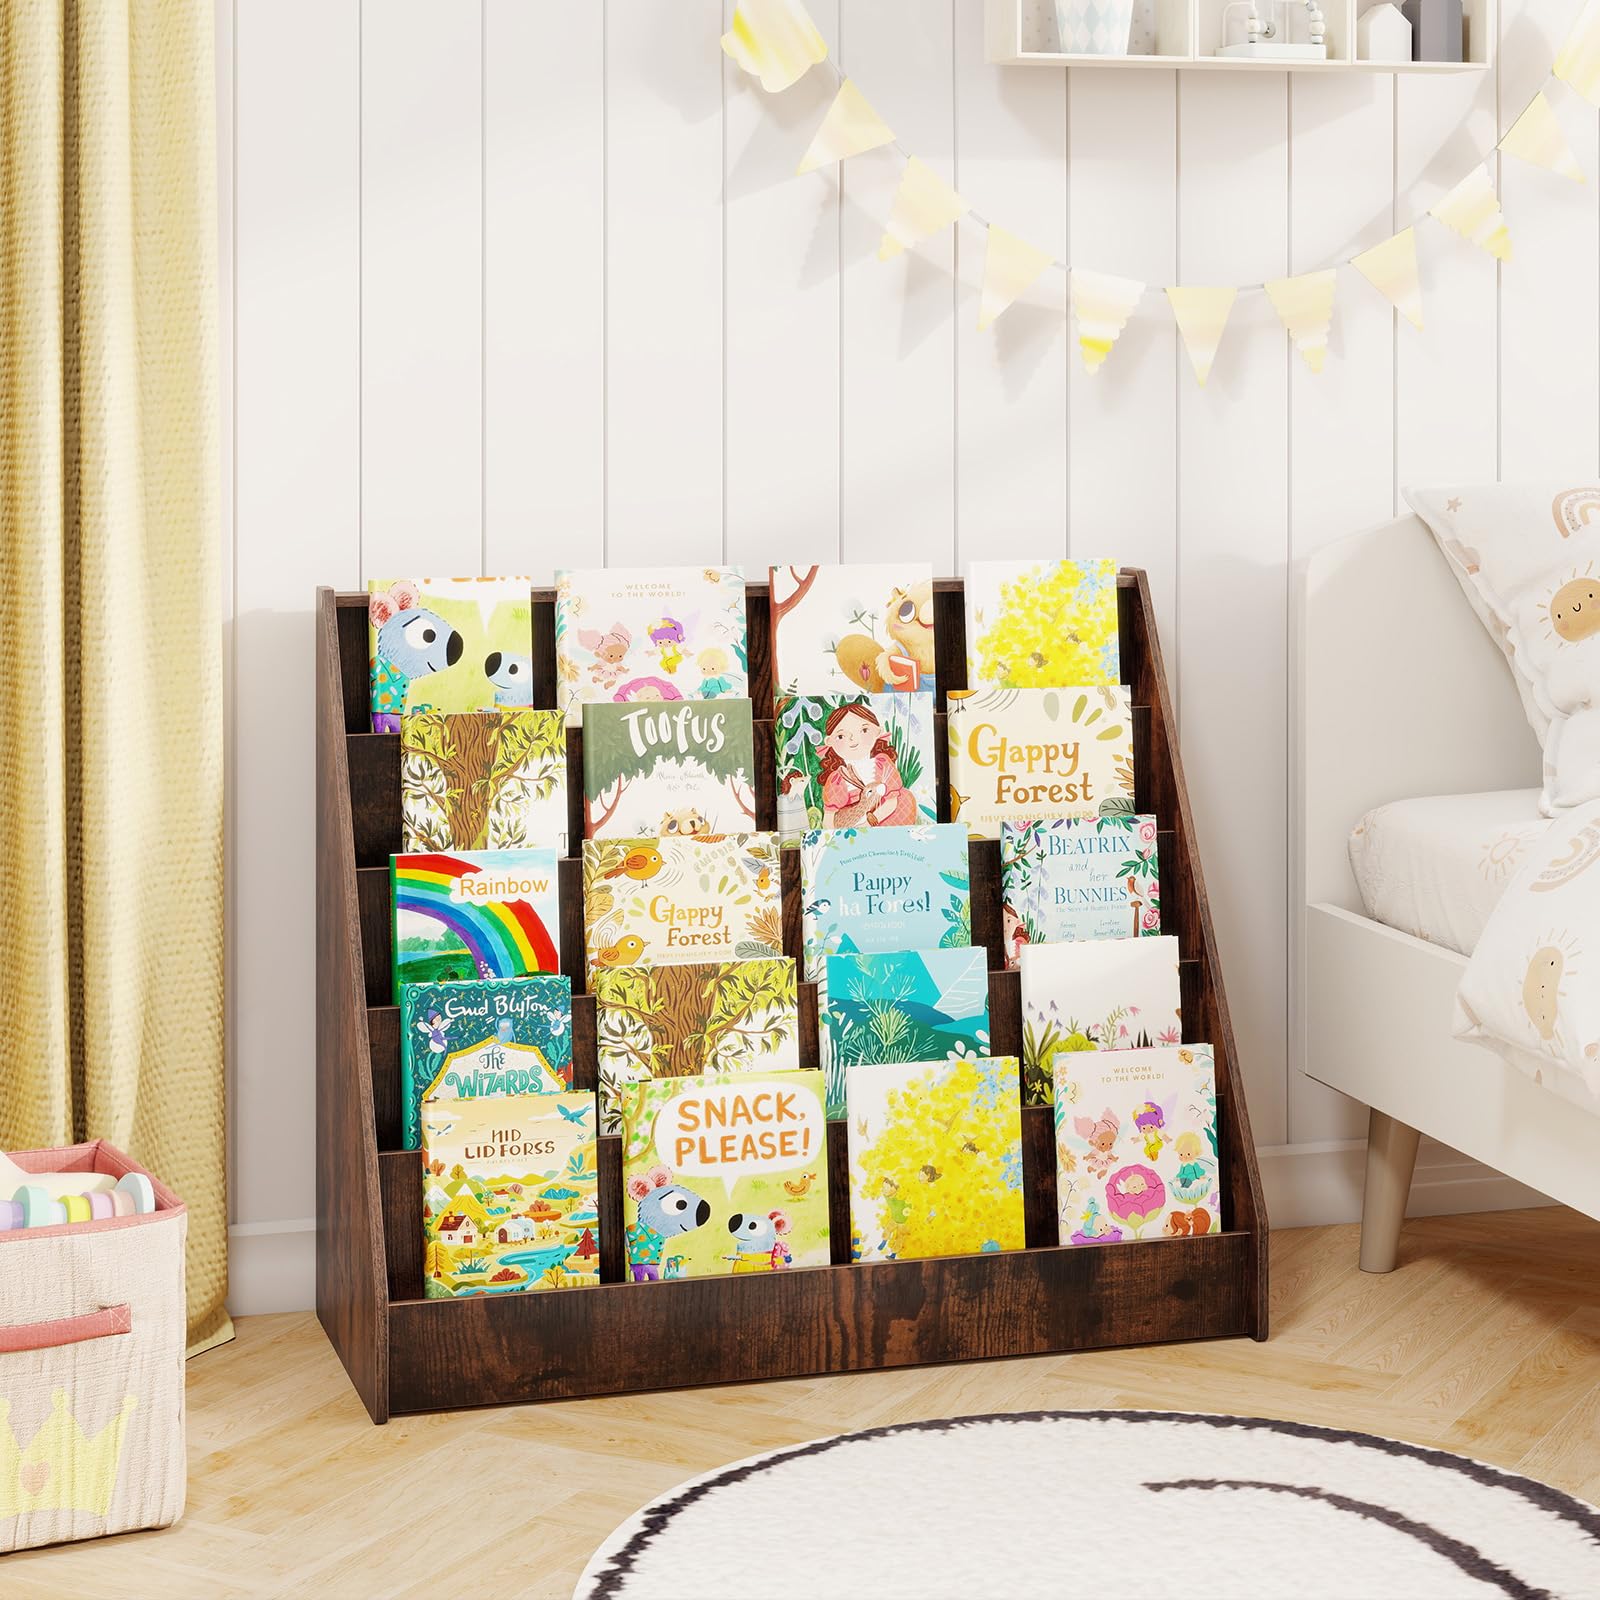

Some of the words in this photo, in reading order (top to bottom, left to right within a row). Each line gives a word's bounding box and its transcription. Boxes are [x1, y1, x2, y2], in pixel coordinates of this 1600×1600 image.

[994, 772, 1094, 804] Forest
[1048, 834, 1130, 856] BEATRIX
[1067, 858, 1089, 872] and
[1089, 870, 1108, 882] her
[460, 876, 549, 897] Rainbow
[1055, 887, 1128, 905] BUNNIES
[666, 925, 732, 947] Forest
[444, 997, 489, 1018] Enid
[493, 994, 552, 1018] Blyton
[479, 1046, 506, 1071] The
[1113, 1066, 1152, 1074] WELCOME
[1133, 1073, 1165, 1081] WORLD!
[677, 1091, 807, 1133] SNACK,
[674, 1127, 811, 1168] PLEASE!
